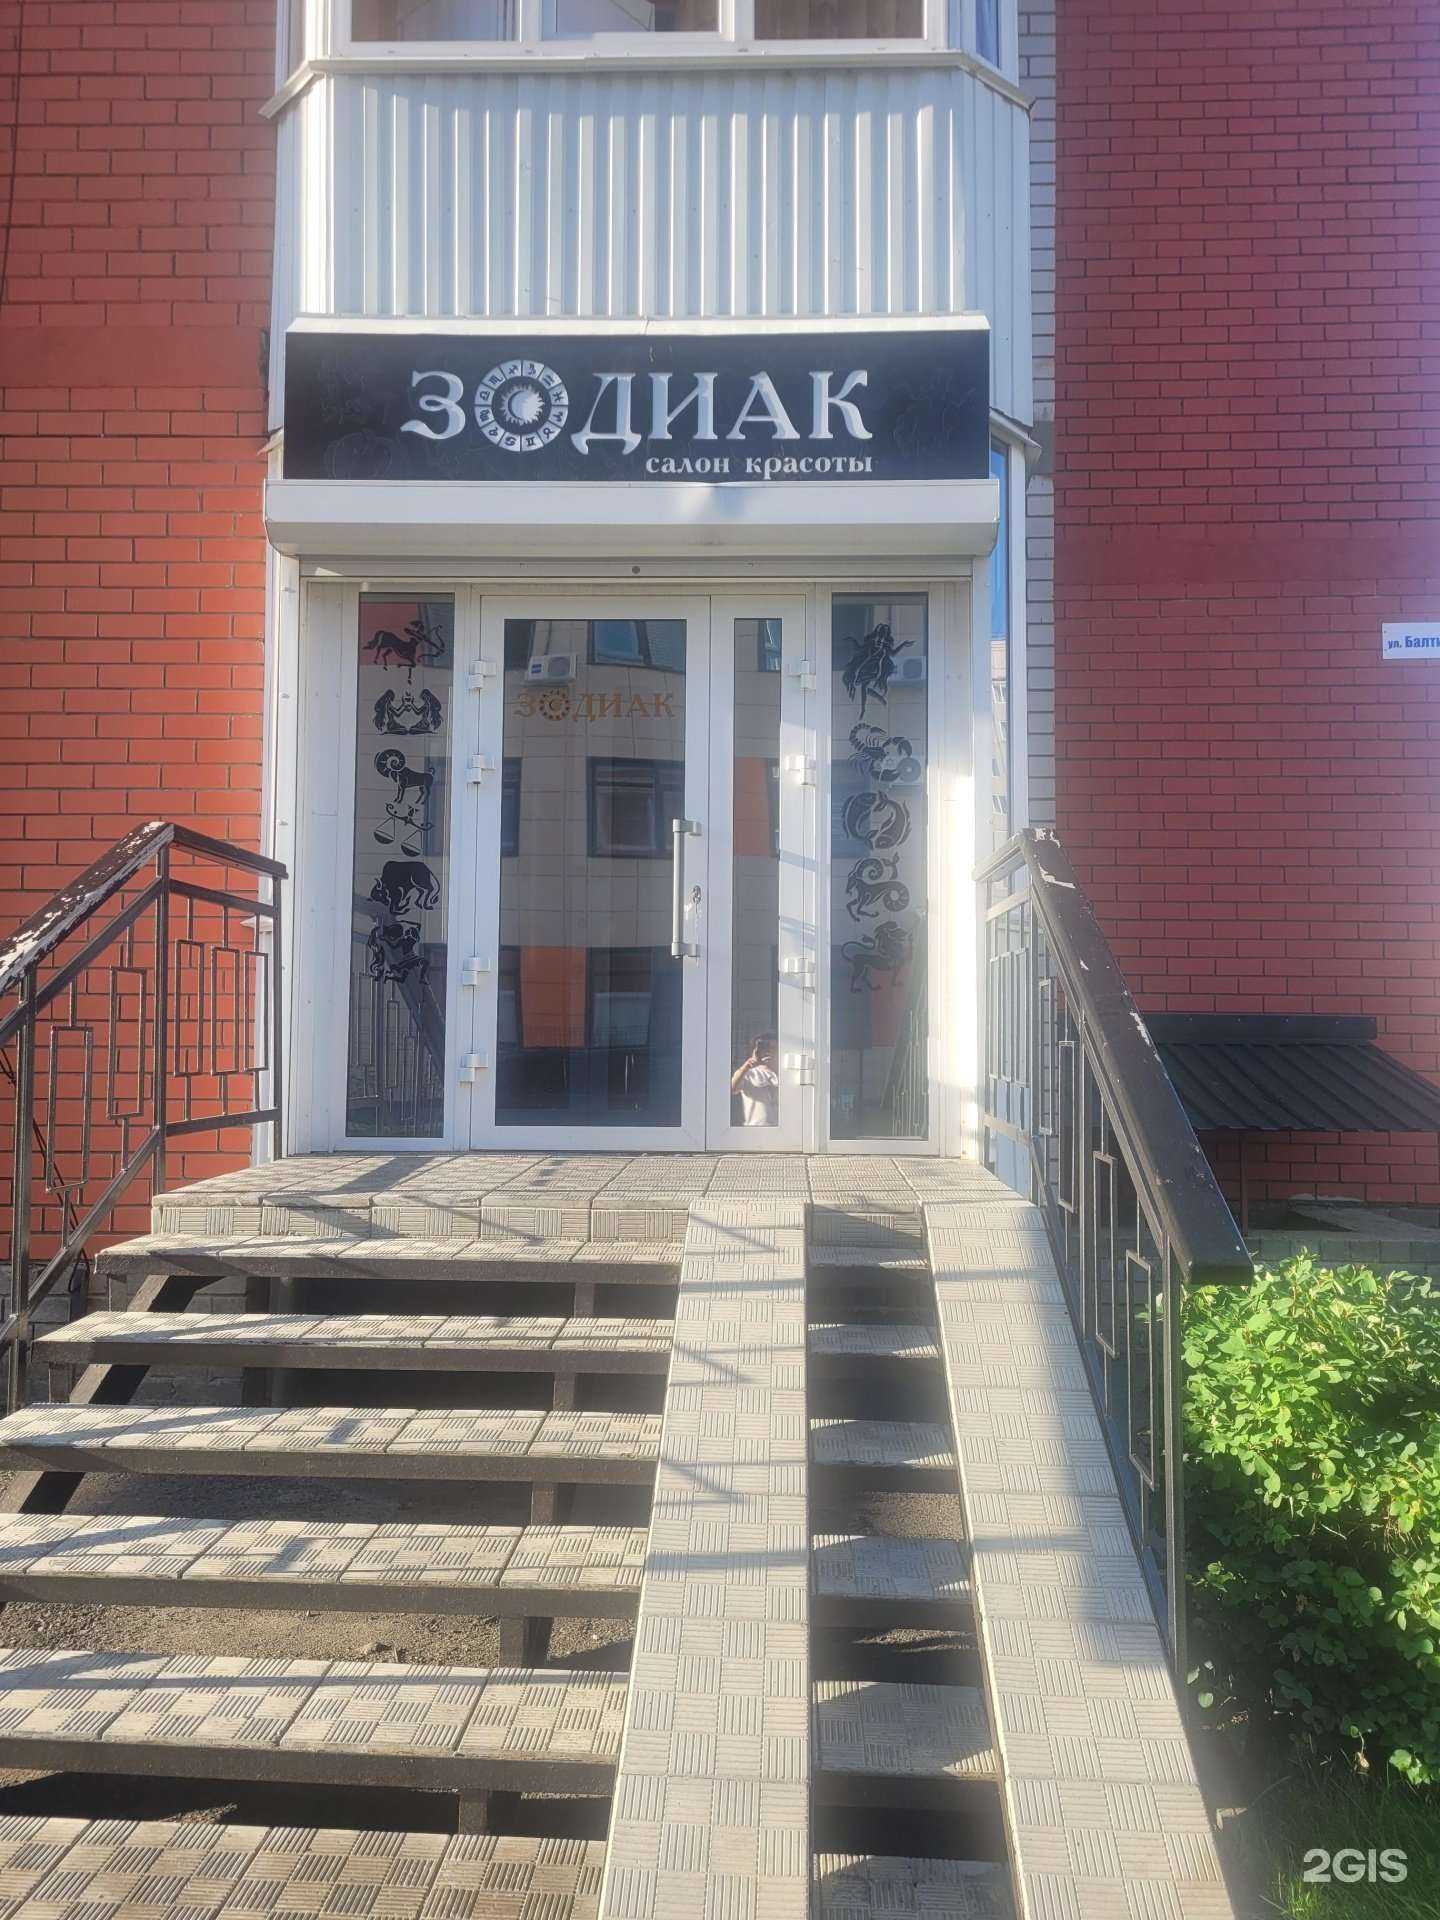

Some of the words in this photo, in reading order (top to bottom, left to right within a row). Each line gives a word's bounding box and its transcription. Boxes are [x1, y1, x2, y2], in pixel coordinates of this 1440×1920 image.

[400, 359, 873, 456] ЗОДИАК
[645, 456, 731, 474] салон
[745, 456, 873, 480] красоты
[1387, 639, 1402, 649] ул.
